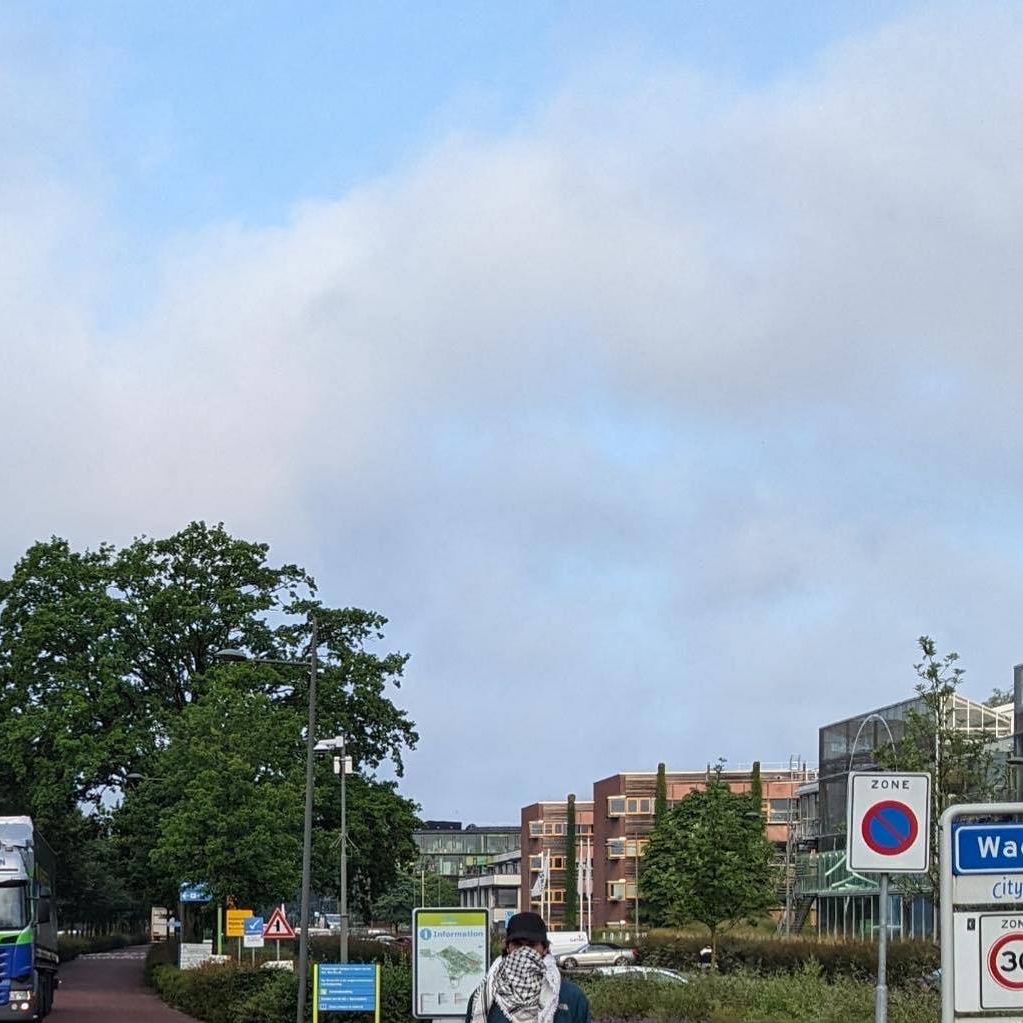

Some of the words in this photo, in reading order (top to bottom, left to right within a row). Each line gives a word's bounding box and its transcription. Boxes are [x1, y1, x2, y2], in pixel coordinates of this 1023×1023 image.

[871, 779, 910, 790] ZONE
[977, 835, 1023, 859] Wa
[992, 876, 1023, 899] City
[433, 928, 483, 938] Information
